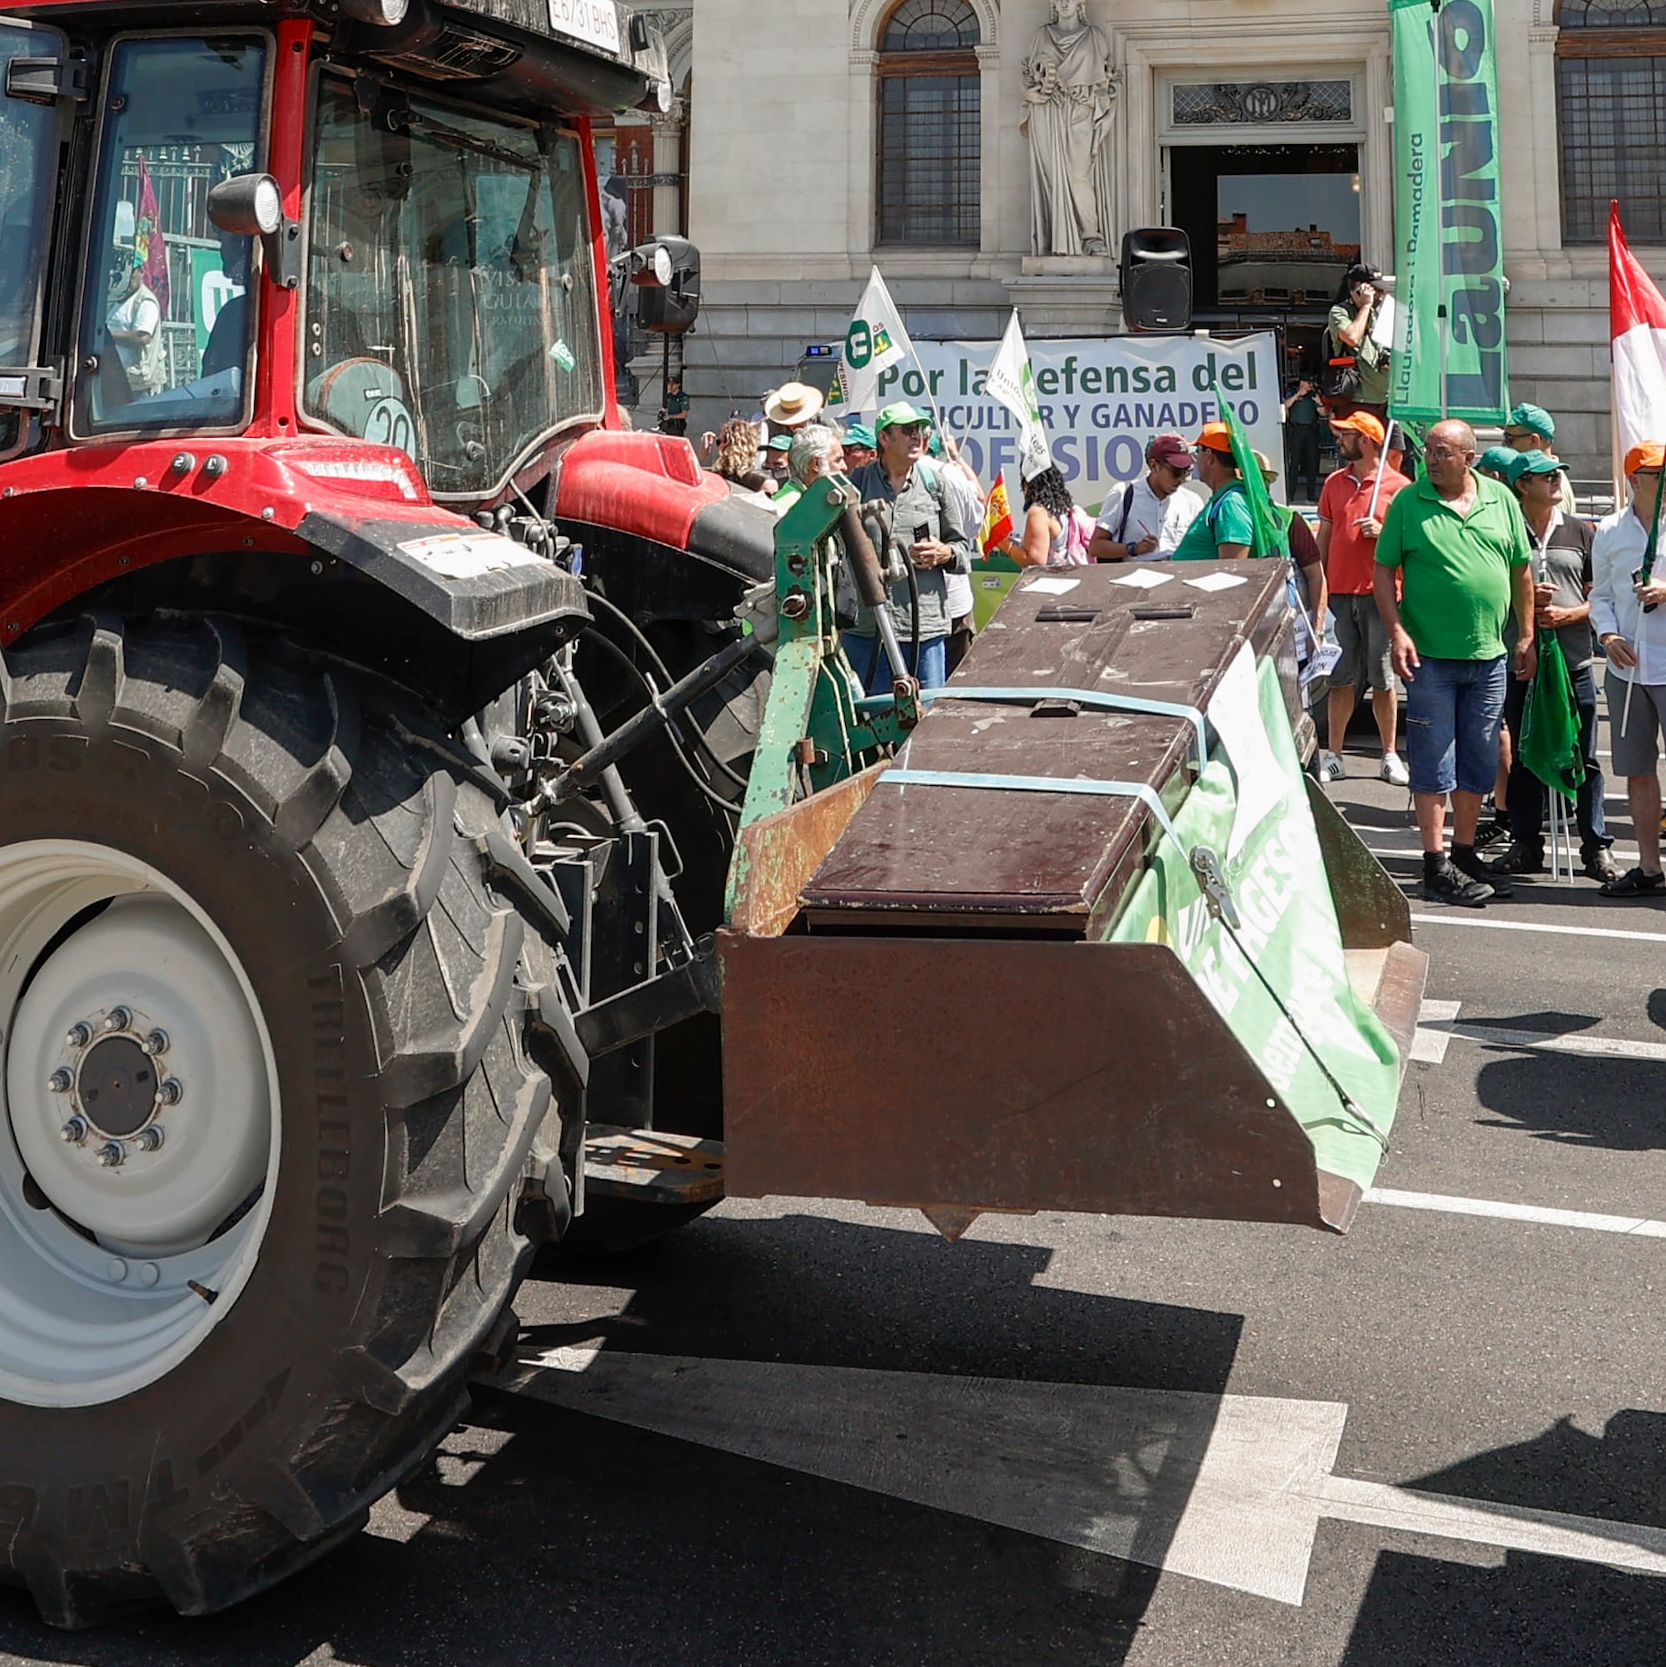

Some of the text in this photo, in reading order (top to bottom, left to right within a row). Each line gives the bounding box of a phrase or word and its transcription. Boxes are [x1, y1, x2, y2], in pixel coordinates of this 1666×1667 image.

[878, 364, 944, 397] Por
[1192, 350, 1258, 394] del
[1062, 404, 1081, 429] Y
